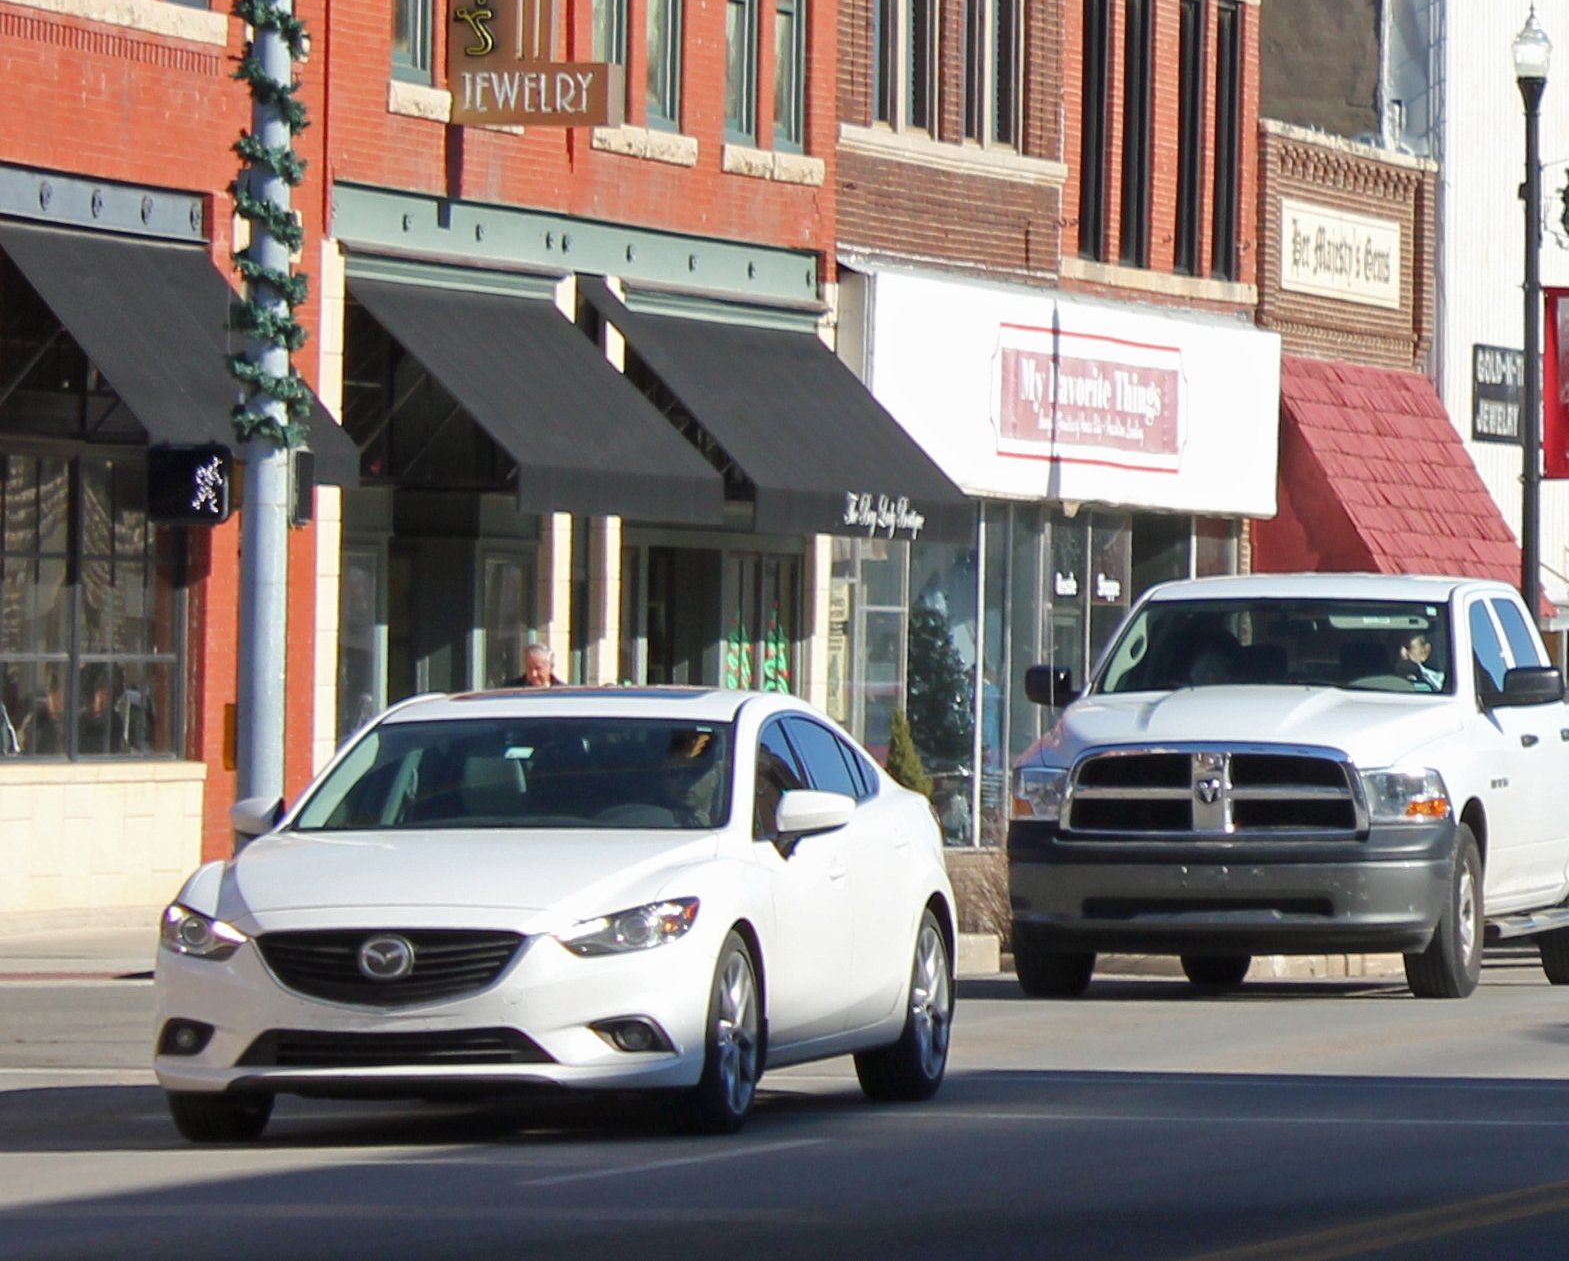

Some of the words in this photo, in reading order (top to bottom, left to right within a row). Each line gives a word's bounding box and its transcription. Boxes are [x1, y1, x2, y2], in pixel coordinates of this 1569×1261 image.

[461, 71, 595, 115] JEWELRY
[1020, 357, 1046, 414] My
[1113, 369, 1162, 426] Things
[1476, 398, 1520, 437] JEWELRY
